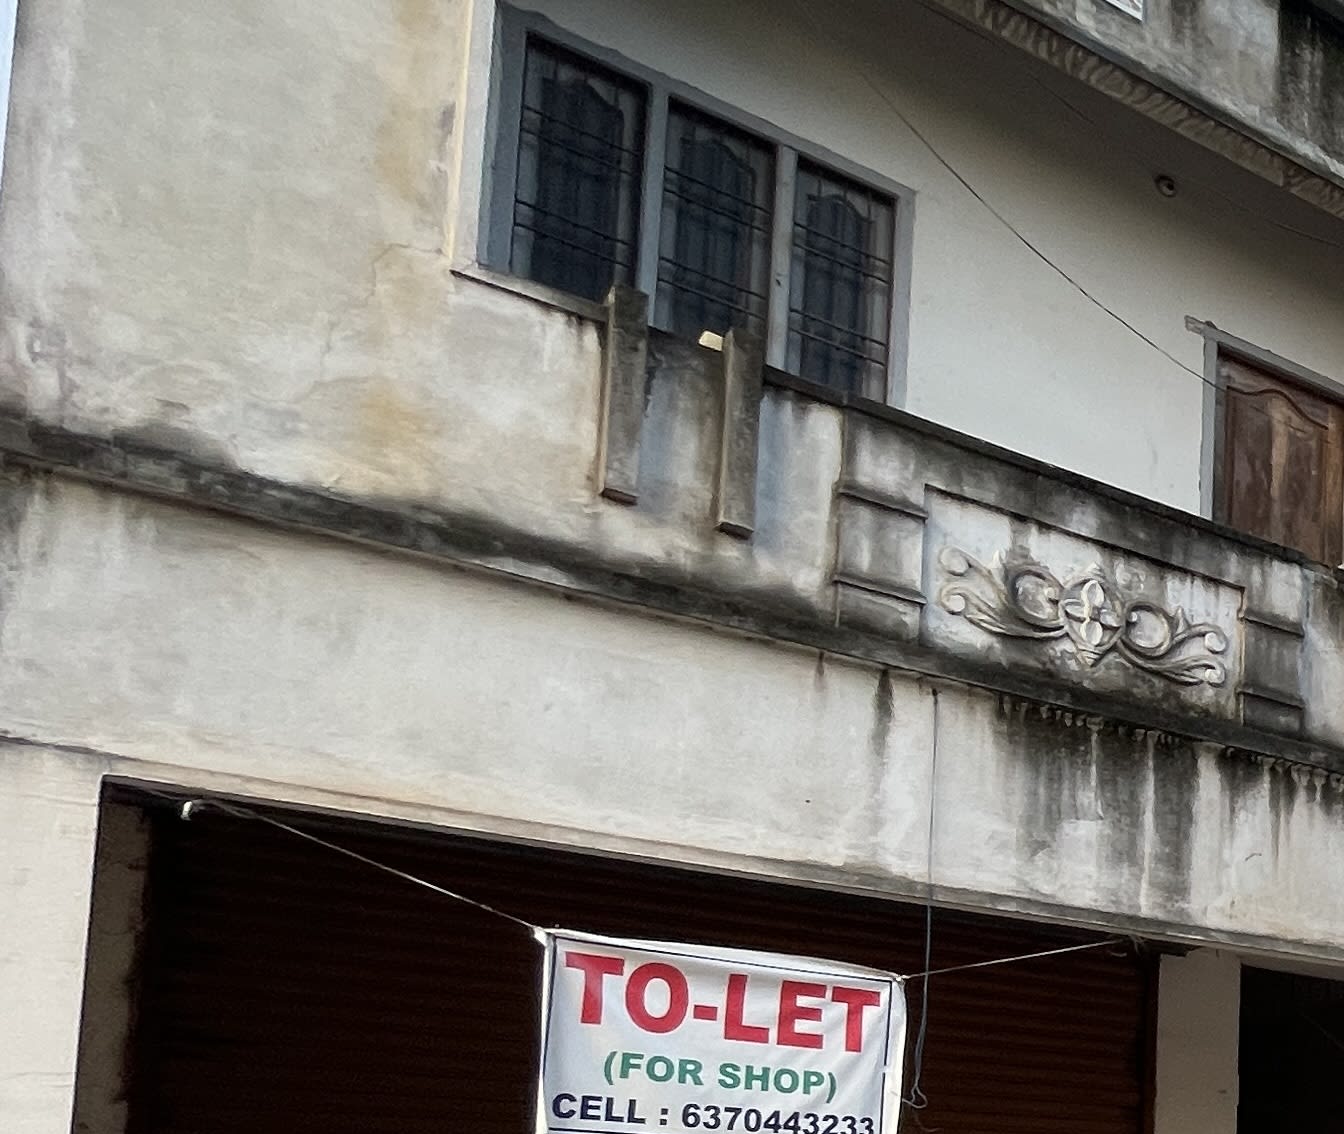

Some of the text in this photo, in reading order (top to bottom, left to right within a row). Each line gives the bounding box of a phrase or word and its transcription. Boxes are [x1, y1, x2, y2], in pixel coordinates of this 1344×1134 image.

[565, 951, 881, 1053] TO-LET
[603, 1051, 837, 1103] (FOR SHOP)
